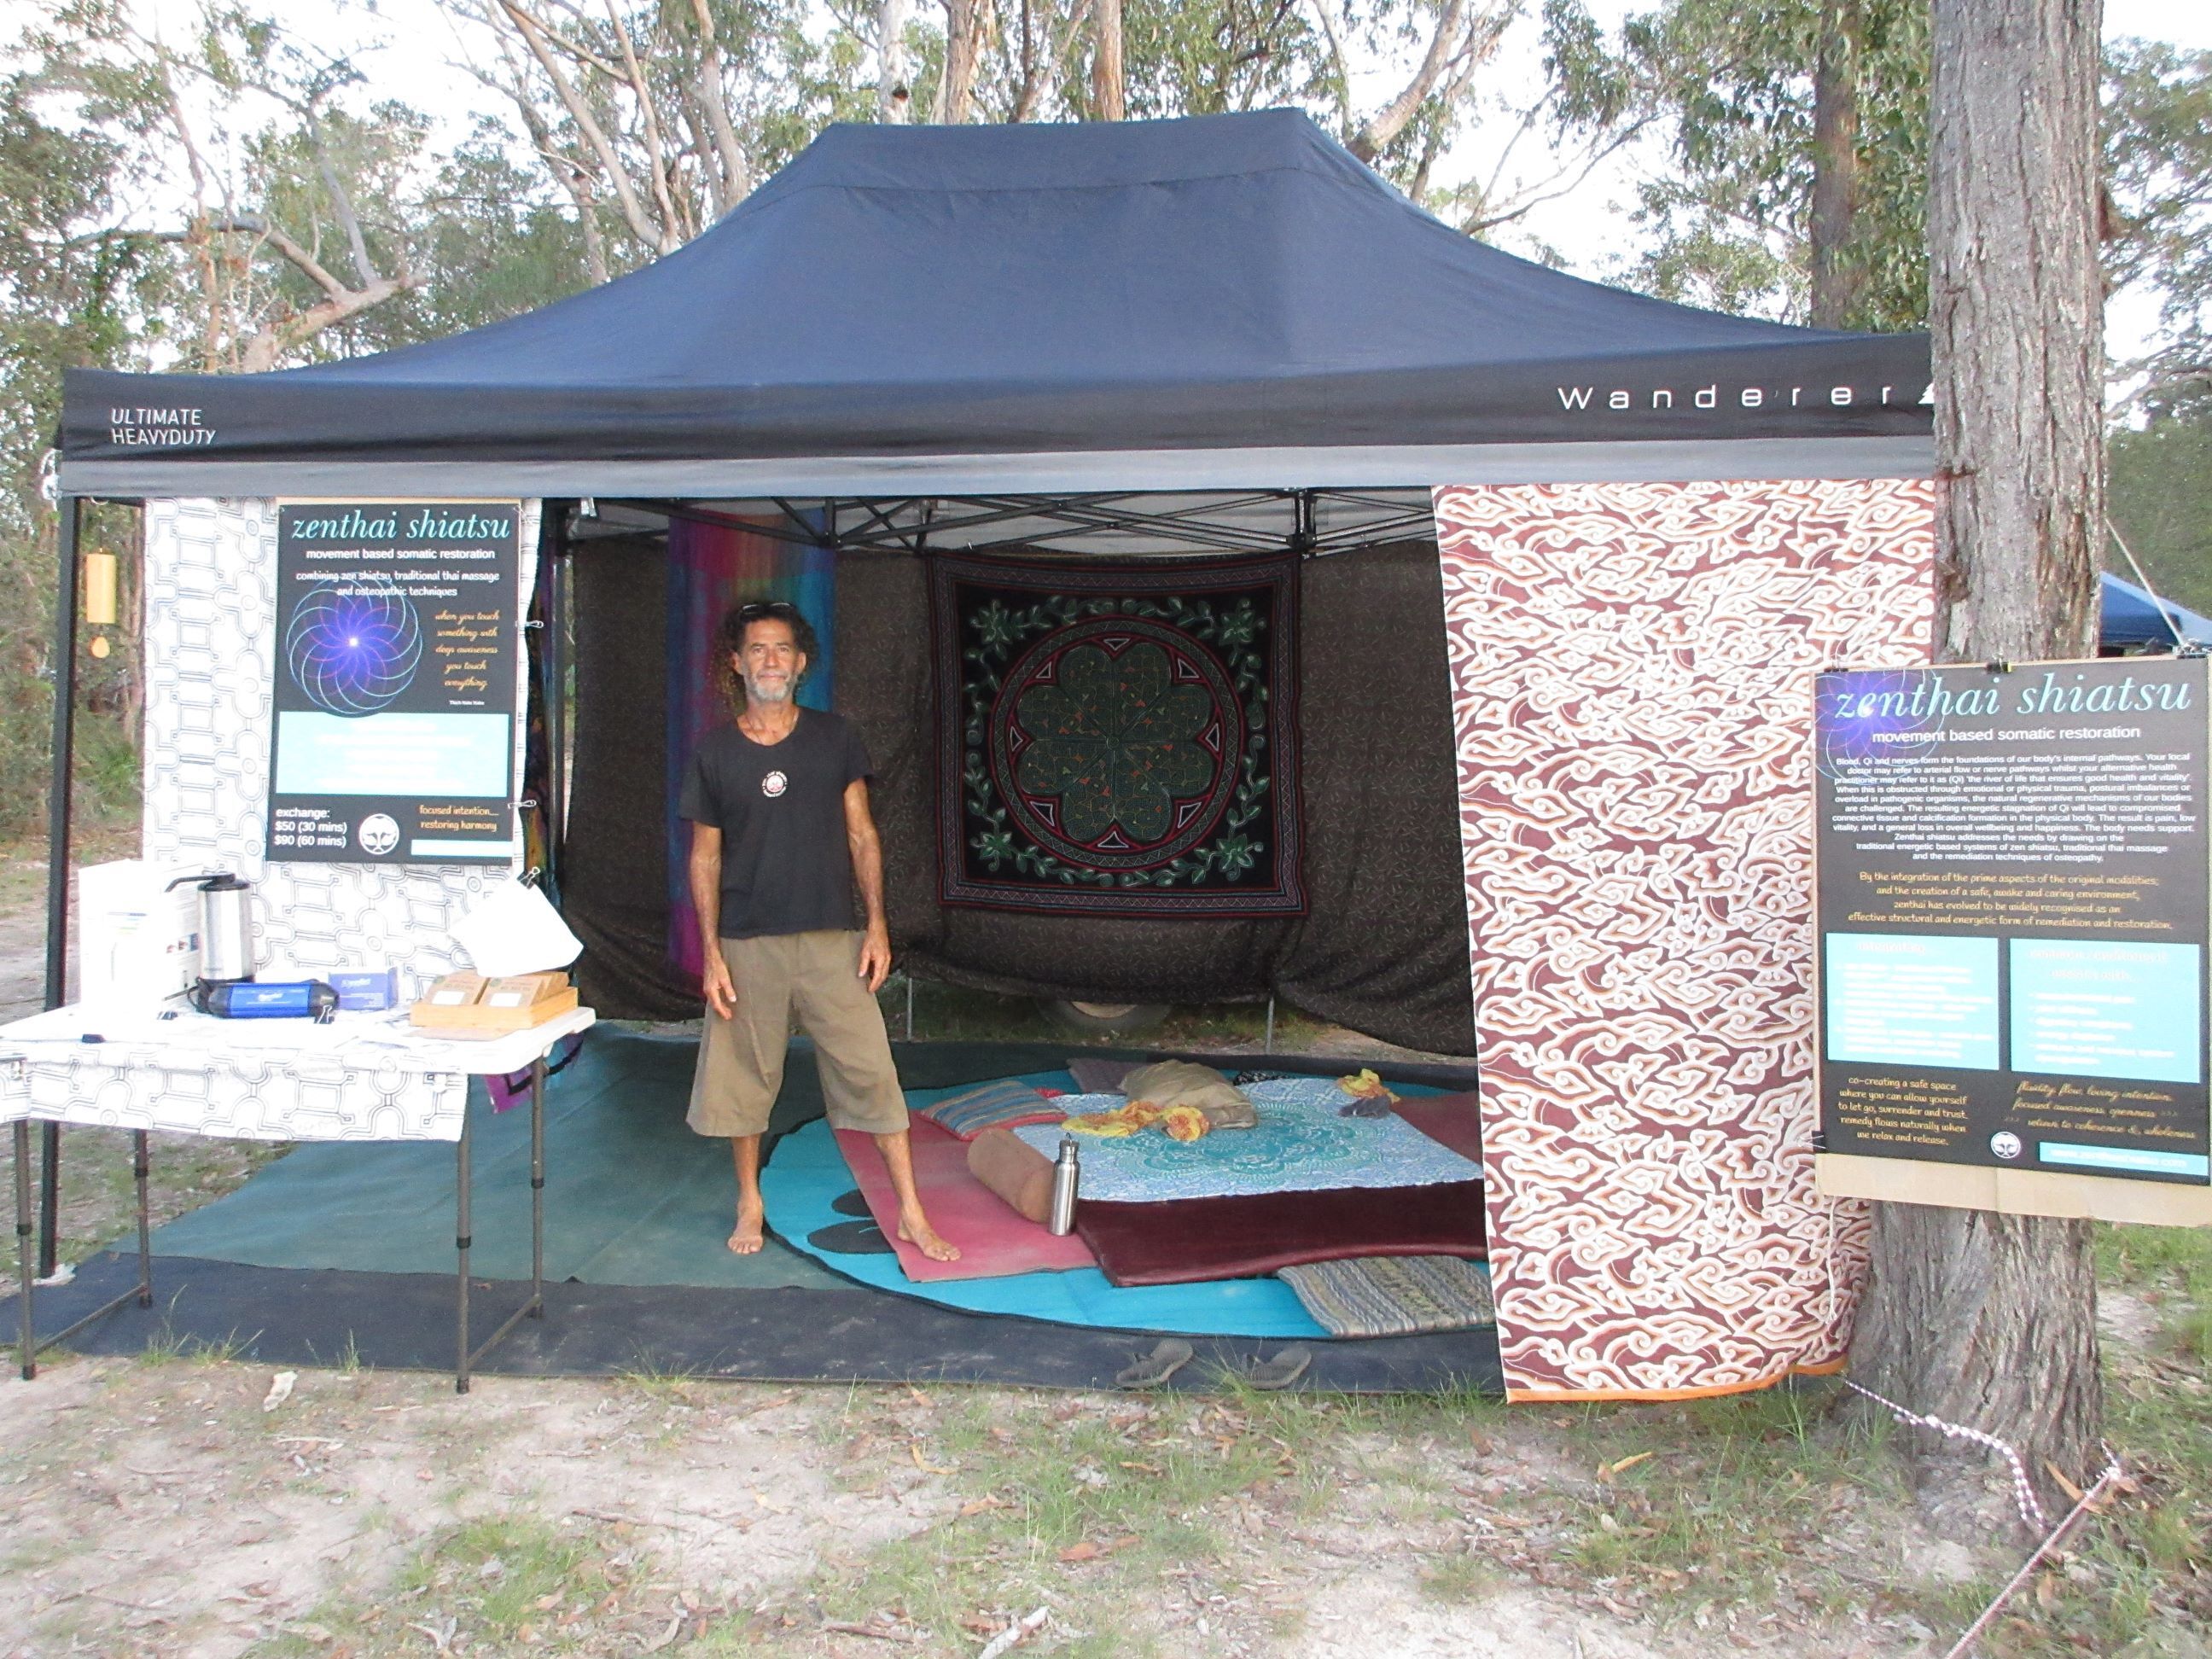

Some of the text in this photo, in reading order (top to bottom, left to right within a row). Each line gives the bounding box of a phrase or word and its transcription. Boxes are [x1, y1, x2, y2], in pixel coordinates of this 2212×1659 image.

[1557, 384, 1891, 410] Wanderer
[111, 408, 202, 425] ULTIMATE
[112, 428, 216, 445] HEAVYDUTY
[291, 509, 510, 539] zenthai shiatsu
[306, 549, 495, 560] movement based somatic restoration
[295, 571, 340, 582] combining
[358, 571, 393, 583] shiatsu,
[394, 570, 440, 581] traditional
[442, 570, 460, 581] thai
[461, 573, 500, 583] massage
[337, 585, 457, 598] and osteopathic techniques
[457, 614, 474, 626] you
[476, 609, 500, 620] touch
[444, 660, 486, 674] you touch
[1834, 672, 2192, 719] zenthai shiatsu
[1871, 725, 2140, 743] movement based somatic restoration
[1836, 785, 1859, 794] When
[1860, 785, 1875, 794] this
[1877, 785, 1883, 794] is
[1885, 785, 1927, 794] obstructed
[1930, 784, 1961, 795] through
[1963, 784, 2004, 793] emotional
[2017, 784, 2051, 795] physical
[2053, 783, 2087, 794] trauma,
[2089, 783, 2125, 794] postural
[2127, 783, 2178, 792] imbalances
[1835, 795, 1868, 803] overload
[1871, 795, 1877, 803] in
[1879, 795, 1924, 805] pathogenic
[1925, 795, 1970, 804] organisms,
[1988, 794, 2017, 802] natural
[2019, 794, 2072, 804] regenerative
[2075, 794, 2130, 802] mechanisms
[2133, 794, 2141, 802] of
[2161, 794, 2192, 802] bodies
[276, 807, 330, 820] exchange:
[419, 805, 452, 814] focused
[275, 821, 347, 834] $50 (30 mins)
[420, 820, 498, 832] restoring harmony
[1832, 824, 1859, 833] vitality,
[1885, 824, 1915, 833] general
[1917, 824, 1934, 832] loss
[1936, 824, 1943, 832] in
[1945, 824, 1972, 832] overall
[1974, 824, 2014, 834] wellbeing
[2016, 824, 2032, 832] and
[2034, 824, 2082, 834] happiness.
[2085, 824, 2101, 832] The
[2103, 824, 2125, 834] body
[2127, 824, 2155, 832] needs
[2157, 824, 2195, 834] support.
[274, 835, 347, 848] $90 (60 mins)
[1894, 833, 1924, 841] Zenthai
[1926, 833, 1955, 841] shiatsu
[1957, 833, 2000, 841] addresses
[2002, 833, 2016, 841] the
[2017, 833, 2045, 841] needs
[2046, 833, 2057, 843] by
[2059, 834, 2093, 843] drawing
[1855, 842, 1895, 851] traditional
[1896, 842, 1933, 853] energetic
[1936, 842, 1960, 851] based
[1963, 843, 1997, 853] systems
[1999, 843, 2007, 852] of
[2027, 843, 2060, 853] shiatsu,
[2063, 843, 2105, 852] traditional
[2107, 844, 2124, 853] thai
[2126, 846, 2168, 854] massage
[1912, 852, 1927, 860] and
[1944, 853, 1993, 861] remediation
[1995, 853, 2041, 863] techniques
[2043, 853, 2052, 861] of
[2053, 853, 2104, 864] osteopathy.
[1859, 871, 1872, 883] By
[1874, 872, 1889, 882] the
[1890, 872, 1939, 884] integration
[1941, 873, 1950, 882] of
[1953, 873, 1968, 882] the
[1970, 873, 1997, 885] prime
[1999, 874, 2035, 886] aspects
[2037, 874, 2046, 884] of
[2049, 875, 2065, 884] the
[2068, 875, 2104, 887] original
[1848, 912, 1886, 923] effective
[1889, 913, 1932, 923] structural
[1935, 914, 1951, 924] and
[1953, 915, 1997, 927] energetic
[1999, 916, 2021, 926] form
[2023, 917, 2033, 926] of
[2034, 917, 2091, 928] remediation
[2093, 918, 2111, 928] and
[1909, 1080, 1928, 1089] safe
[1930, 1083, 1957, 1093] space
[1839, 1088, 1866, 1098] where
[1868, 1092, 1883, 1102] you
[1903, 1092, 1927, 1103] allow
[1929, 1094, 1967, 1107] yourself
[1838, 1102, 1848, 1111] to
[1849, 1103, 1861, 1112] let
[1877, 1104, 1922, 1116] surrender
[1924, 1108, 1940, 1117] and
[1840, 1115, 1966, 1132] remedy flows naturally when
[1871, 1131, 1893, 1141] relax
[1895, 1132, 1911, 1143] and
